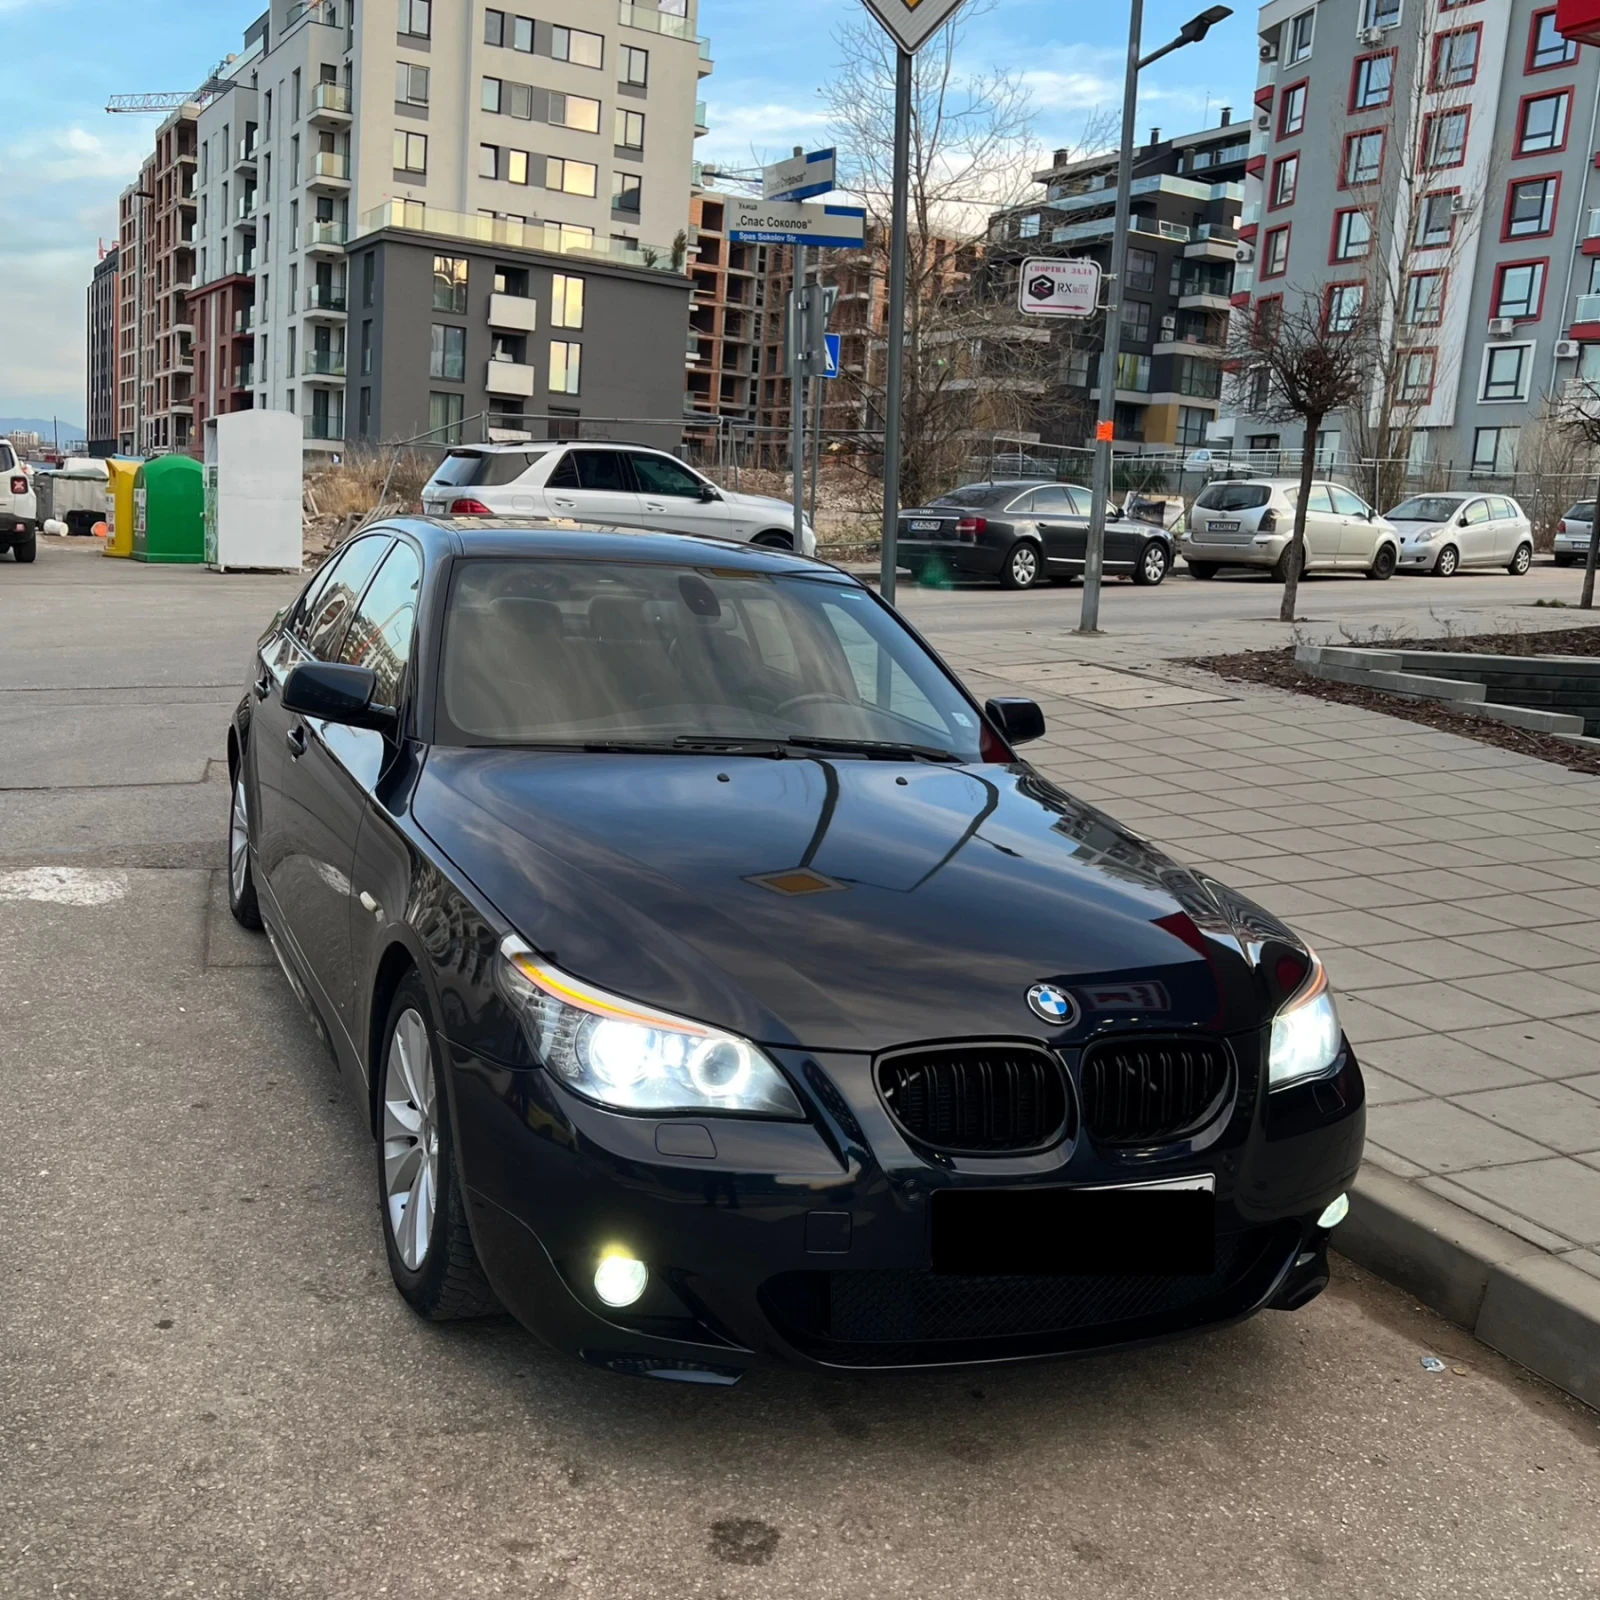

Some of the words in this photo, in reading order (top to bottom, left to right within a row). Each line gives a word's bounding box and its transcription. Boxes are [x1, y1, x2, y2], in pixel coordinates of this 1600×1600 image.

[738, 202, 758, 211] Улица
[738, 231, 757, 242] Spas
[757, 232, 785, 242] Sokolov
[1057, 282, 1073, 294] RX
